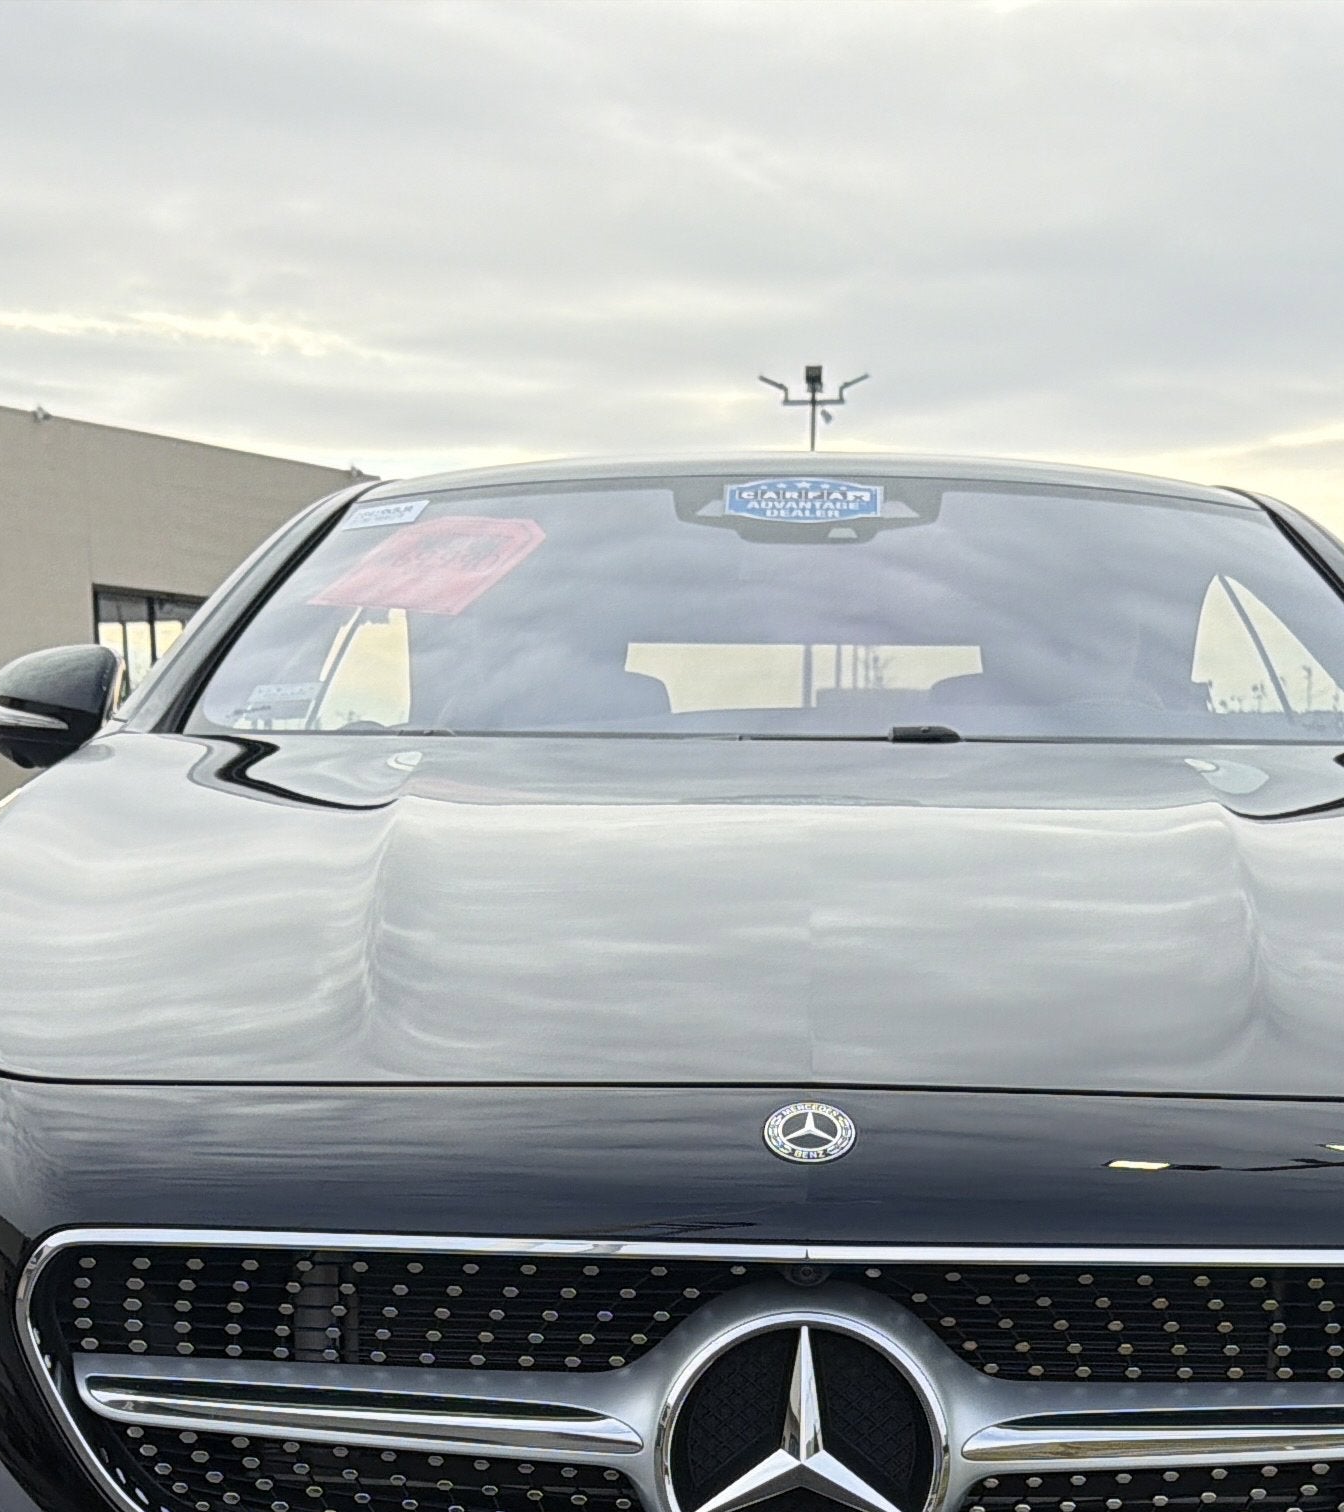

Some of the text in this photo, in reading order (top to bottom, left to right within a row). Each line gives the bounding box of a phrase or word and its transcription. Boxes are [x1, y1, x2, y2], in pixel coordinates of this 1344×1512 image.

[746, 499, 860, 510] ADVANTAGE
[765, 509, 841, 518] DEALER
[793, 1150, 826, 1159] BENZ
